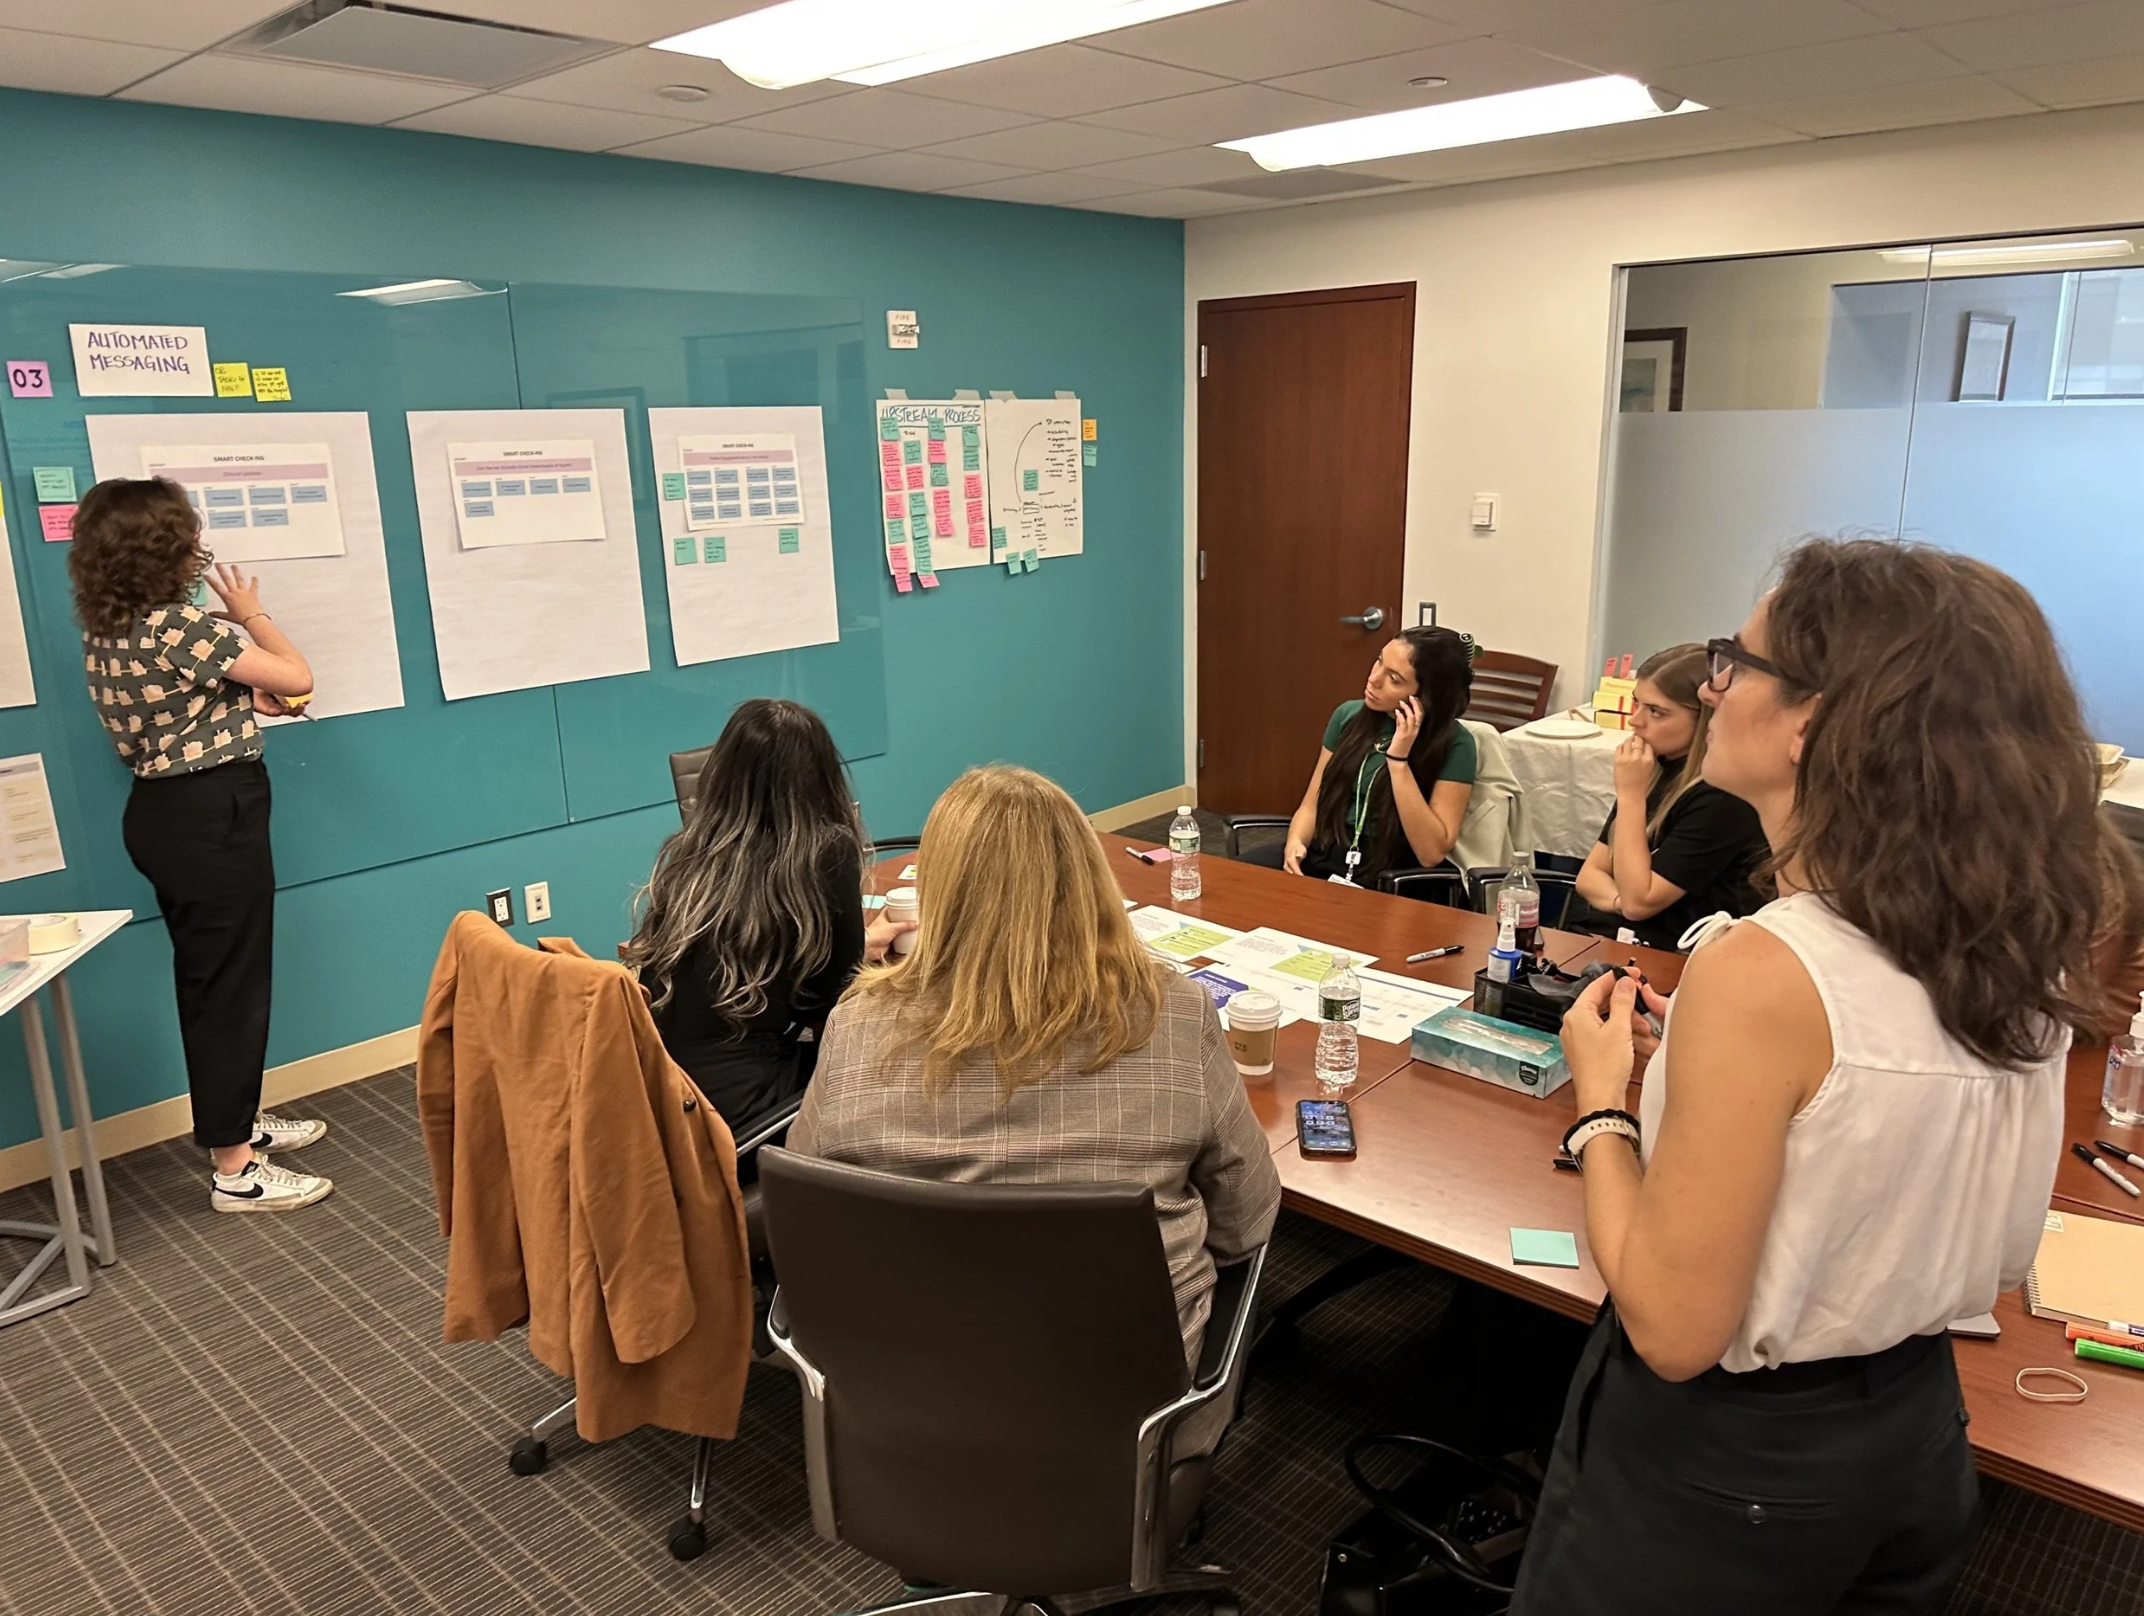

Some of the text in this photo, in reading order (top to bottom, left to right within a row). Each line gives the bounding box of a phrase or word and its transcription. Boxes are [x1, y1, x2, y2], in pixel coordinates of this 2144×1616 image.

[87, 331, 188, 350] AUTOMATED
[89, 354, 190, 374] MESSAGING
[13, 369, 43, 388] 03
[881, 406, 981, 424] UPSTREAM PROCESS
